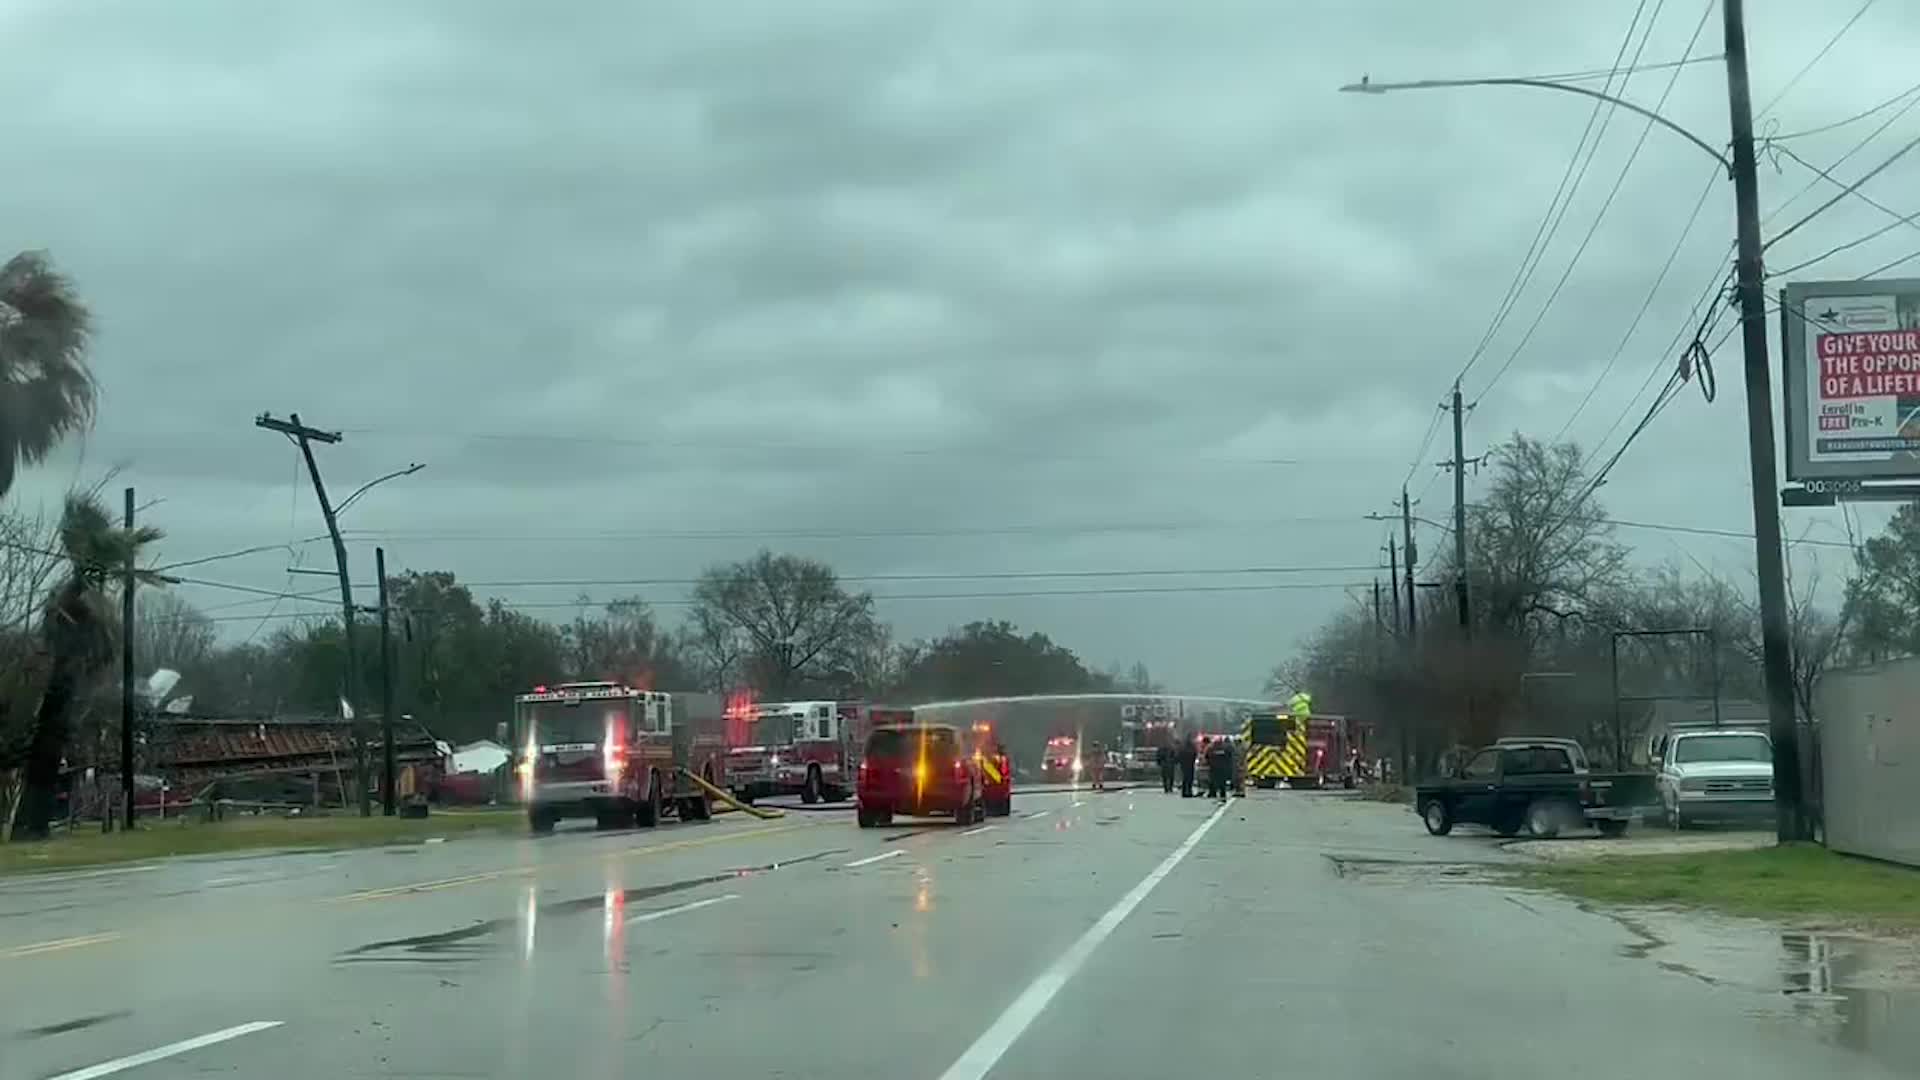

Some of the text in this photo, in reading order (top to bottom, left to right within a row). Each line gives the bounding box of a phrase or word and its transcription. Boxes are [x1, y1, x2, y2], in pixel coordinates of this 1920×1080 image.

[1824, 332, 1918, 354] GIVE YOUR
[1824, 356, 1859, 375] THE
[1826, 376, 1849, 396] OF
[1852, 377, 1863, 395] A
[1822, 404, 1865, 417] Enroll in
[1822, 415, 1883, 429] FREE Pre-K
